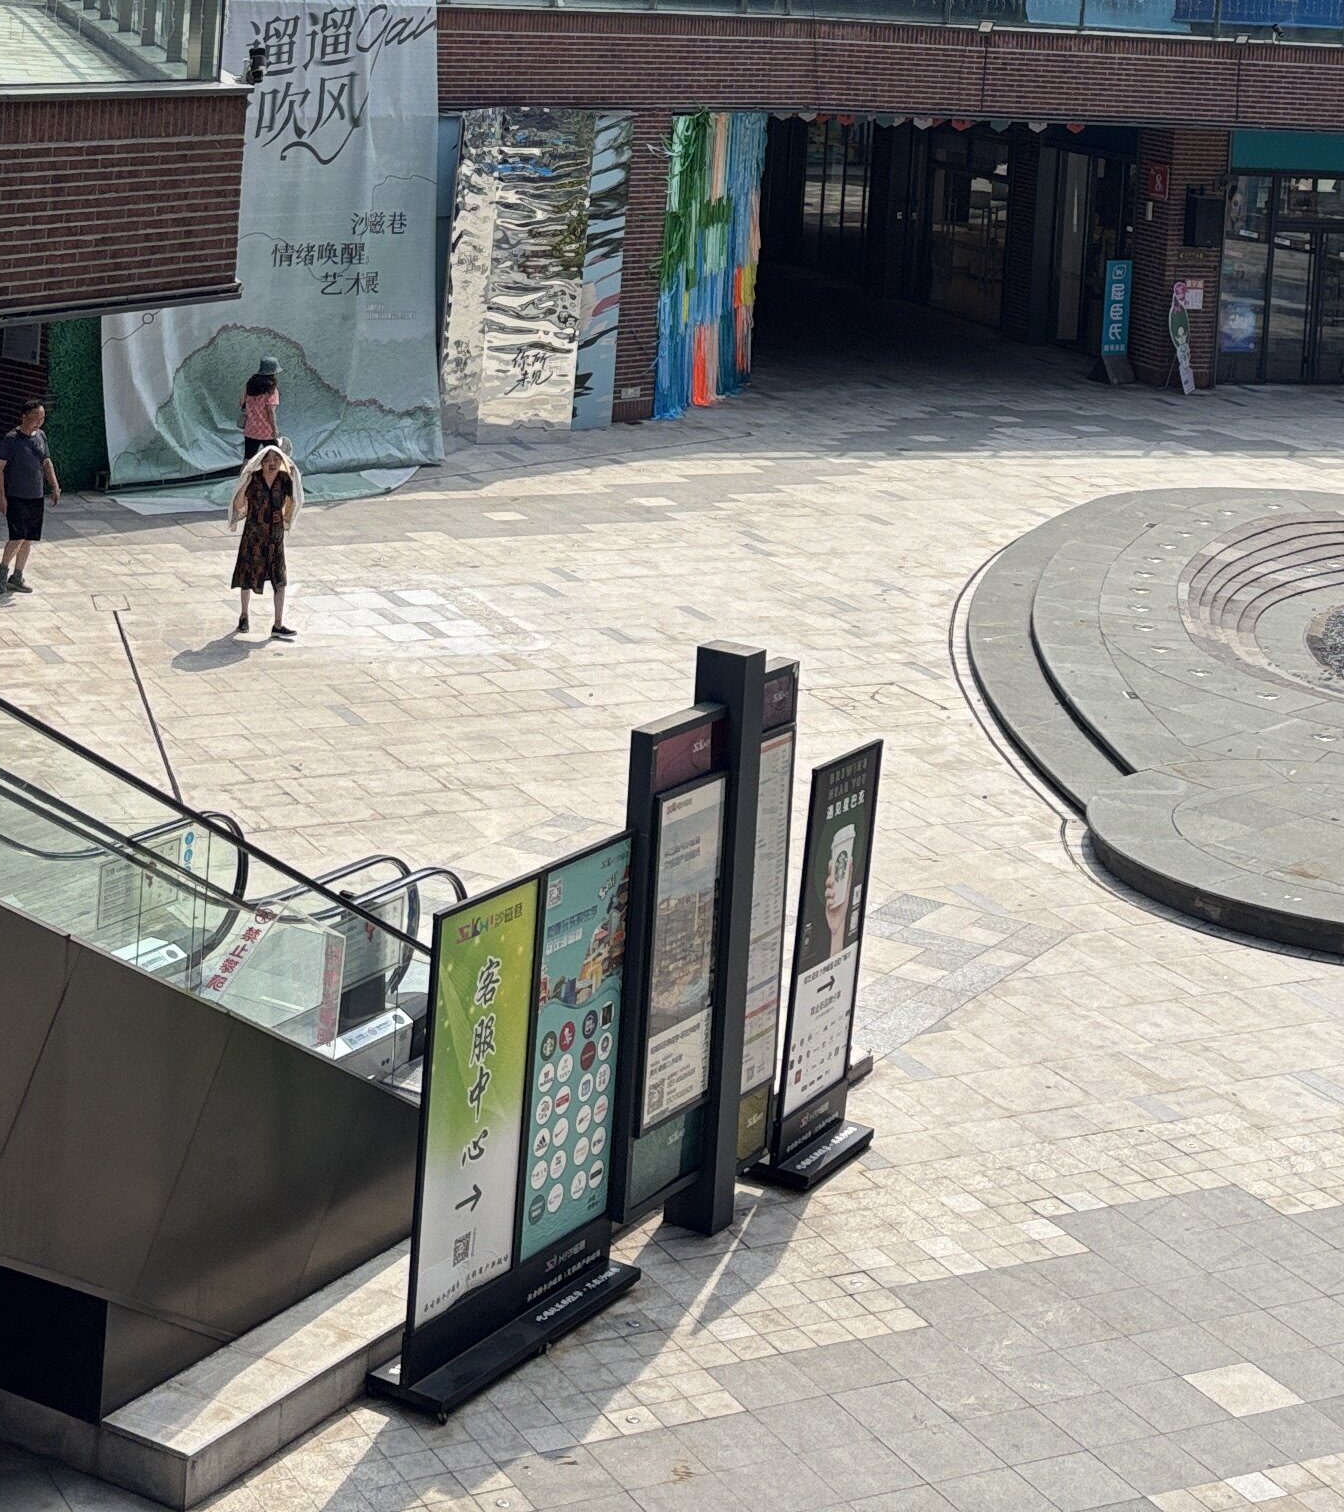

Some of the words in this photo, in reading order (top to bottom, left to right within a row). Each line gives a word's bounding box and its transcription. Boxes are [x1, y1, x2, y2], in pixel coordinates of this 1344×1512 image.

[255, 71, 362, 149] 吹风
[350, 211, 407, 236] 沙磁巷
[271, 241, 366, 268] 情绪唤醒
[320, 271, 379, 296] 艺术展
[462, 955, 502, 1168] 客服中心
